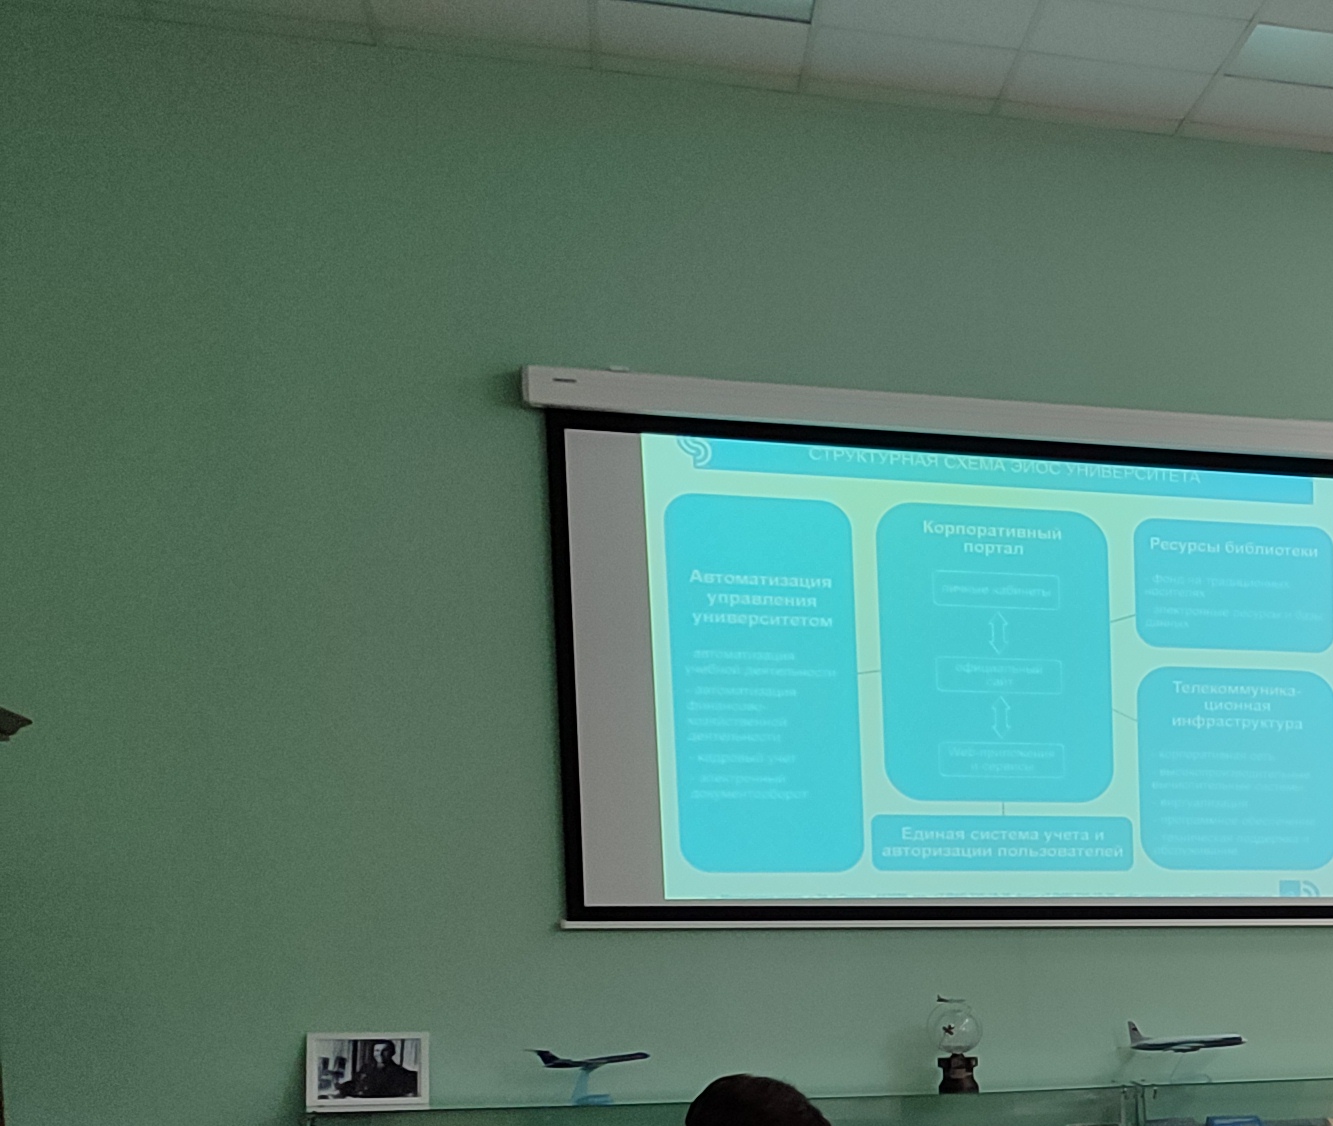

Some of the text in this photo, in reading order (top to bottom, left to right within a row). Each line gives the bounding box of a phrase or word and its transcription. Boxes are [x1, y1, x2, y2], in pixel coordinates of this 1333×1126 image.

[808, 446, 938, 468] СТРУКТУРНАЯ
[943, 456, 1006, 472] СХЕМА
[1066, 462, 1201, 484] УНИВЕРСИТЕТА
[922, 519, 1062, 541] Корпоративный
[963, 542, 1024, 557] портал
[1149, 536, 1318, 558] Ресурсы библиотеки
[689, 568, 833, 590] Автоматизация
[706, 593, 817, 608] управления
[692, 612, 834, 628] университетом
[1172, 680, 1302, 698] Телекоммуника-
[1203, 701, 1271, 712] ционная
[1172, 715, 1304, 732] инфраструктура
[901, 826, 1105, 844] Единая система учета и
[881, 844, 1124, 860] авторизации пользователей
